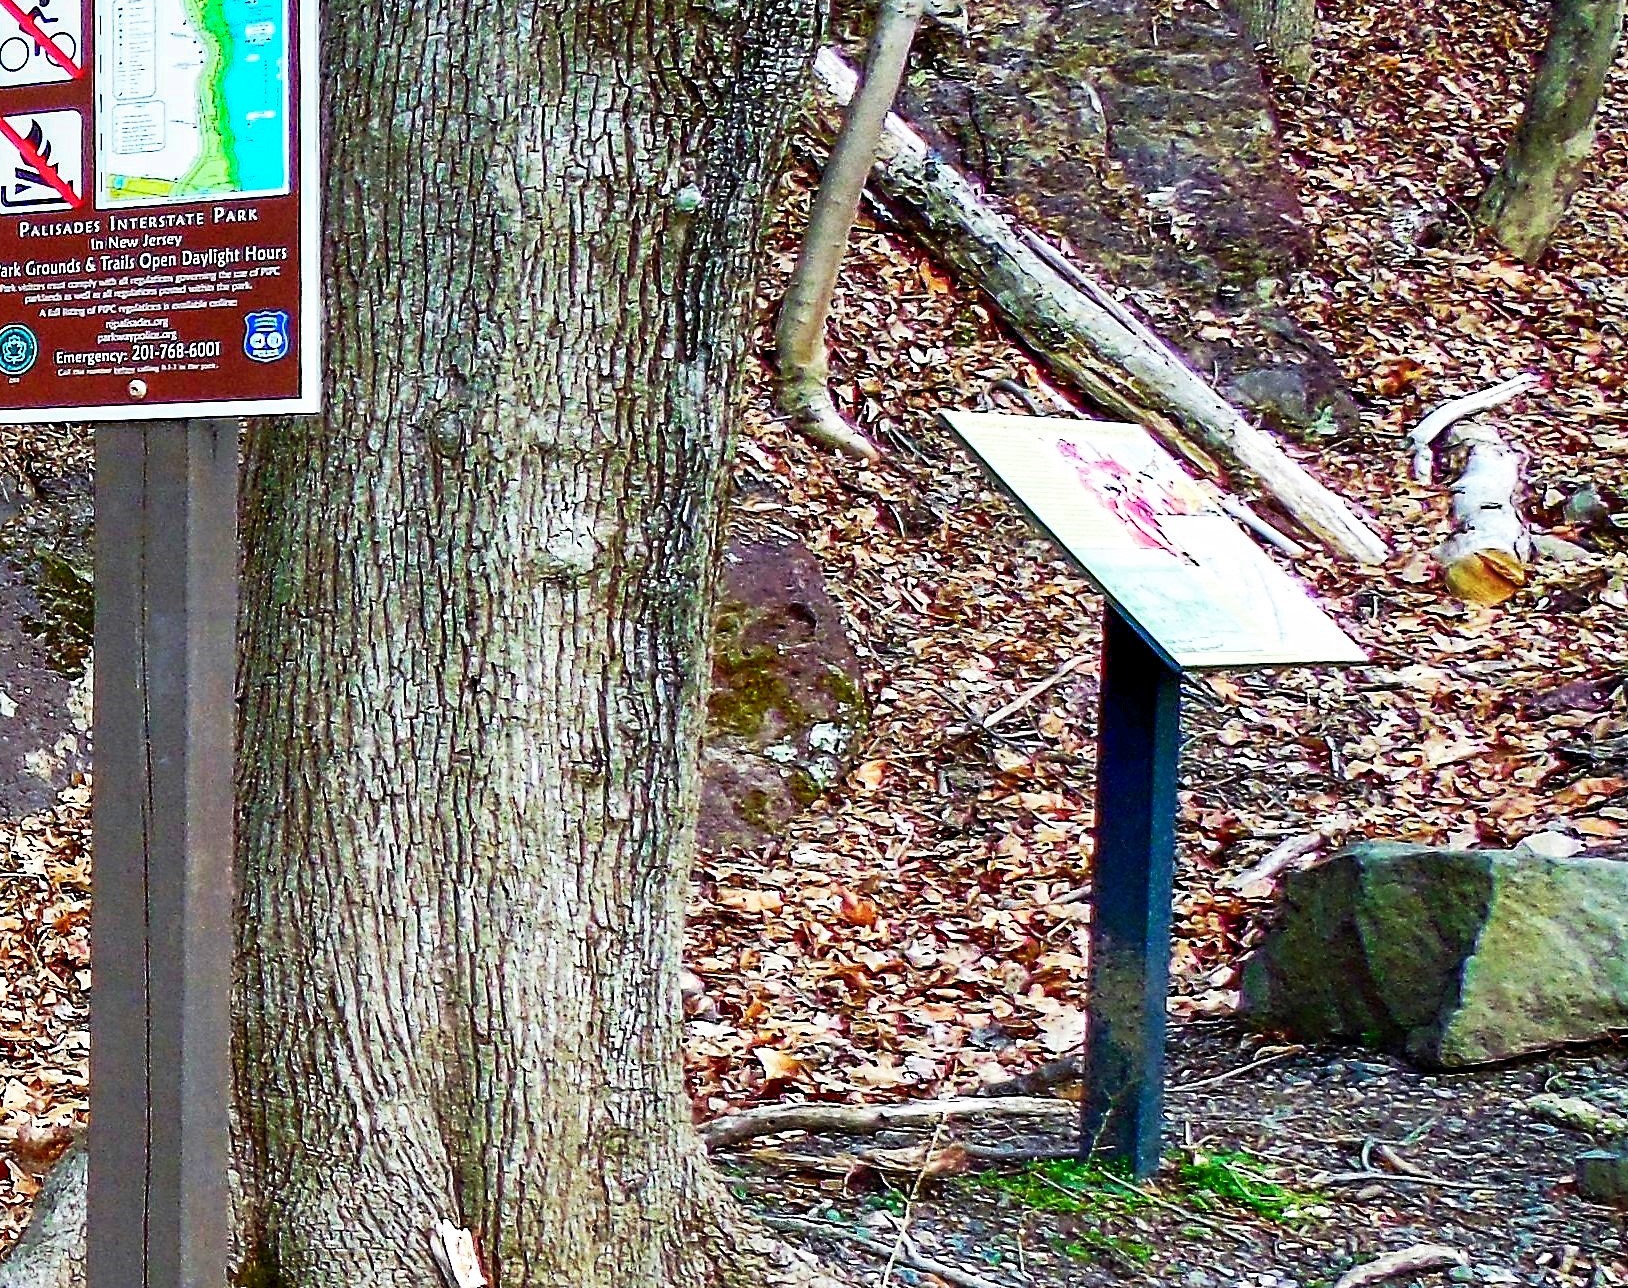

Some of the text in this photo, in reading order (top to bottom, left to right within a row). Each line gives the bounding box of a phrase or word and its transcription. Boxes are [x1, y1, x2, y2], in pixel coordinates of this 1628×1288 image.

[19, 207, 258, 238] PALISADES INTERSTATE PARK
[108, 236, 139, 249] New
[142, 233, 182, 247] Jersey
[25, 258, 81, 276] Grounds
[85, 257, 96, 272] &
[100, 254, 135, 271] Trails
[139, 253, 176, 271] Open
[182, 248, 240, 268] Daylight
[245, 246, 287, 262] Hours
[56, 350, 129, 366] Emergency:
[132, 341, 220, 361] 201-768-6001
